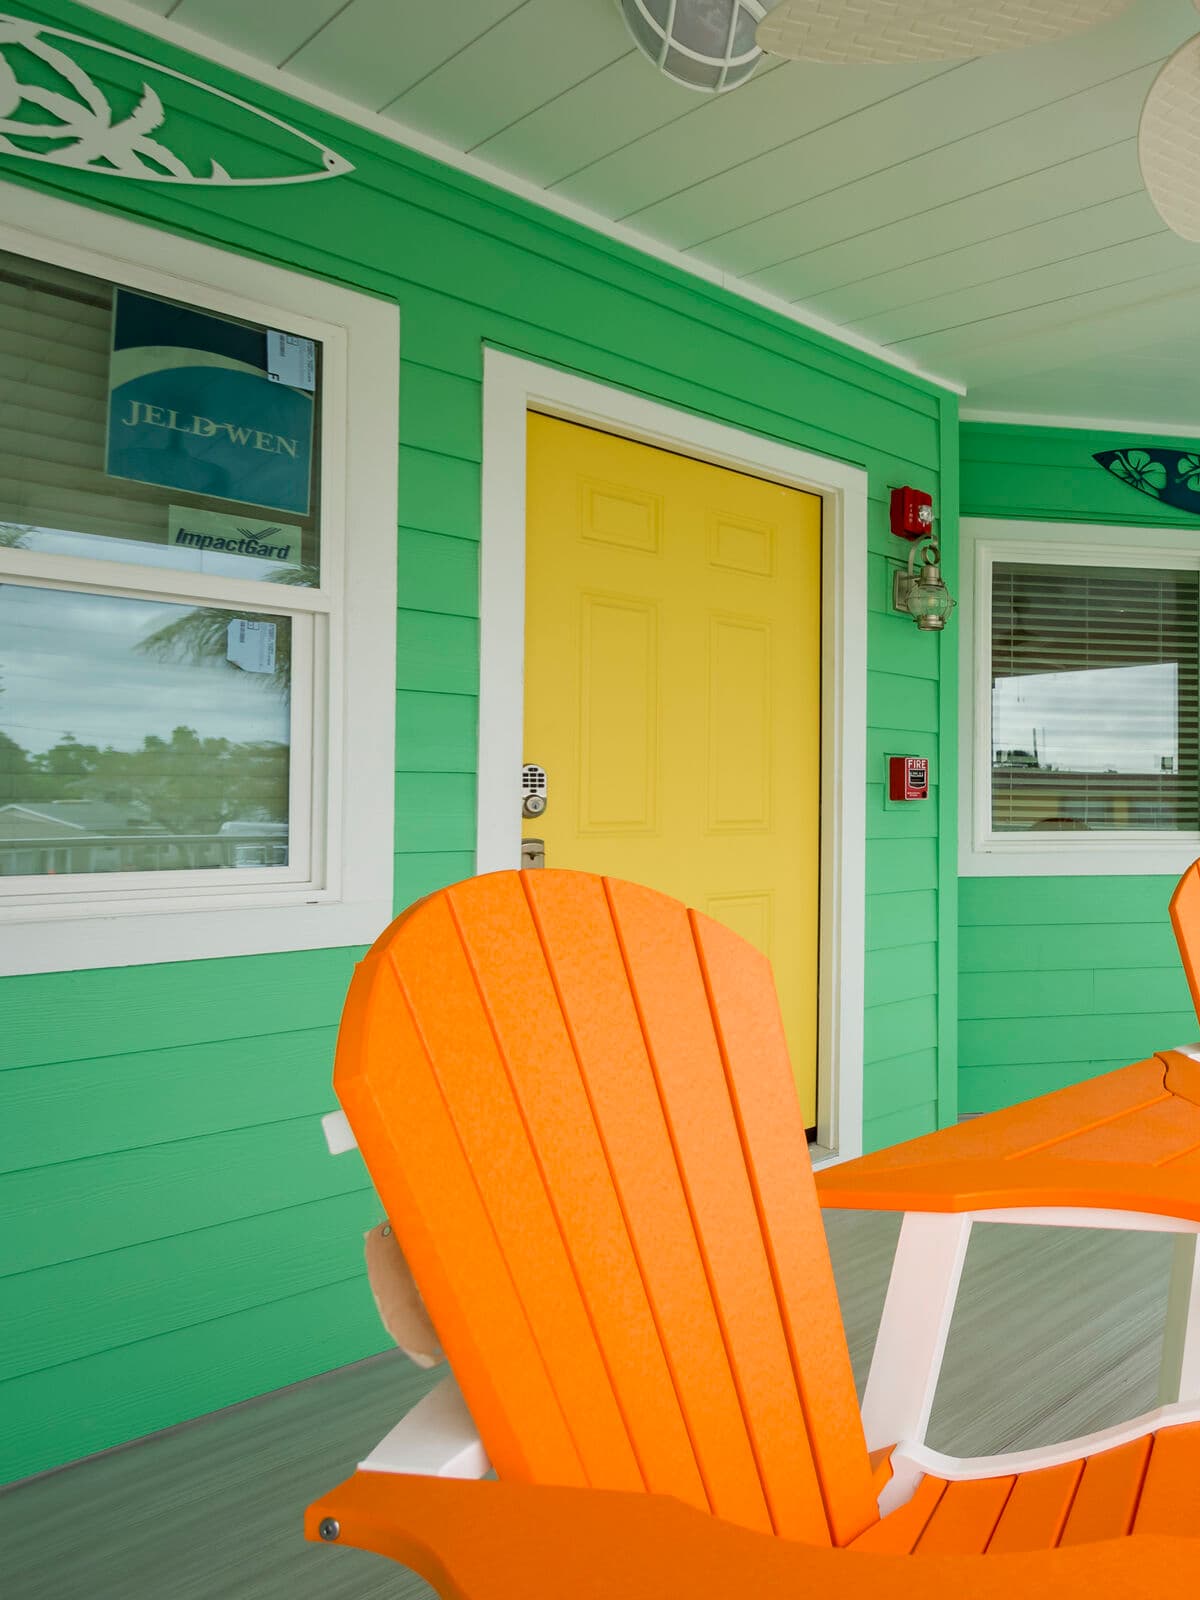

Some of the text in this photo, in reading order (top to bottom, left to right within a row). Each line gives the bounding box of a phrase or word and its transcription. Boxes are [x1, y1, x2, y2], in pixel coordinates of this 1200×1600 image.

[122, 400, 299, 459] JELD-WEN
[175, 527, 291, 561] ImpactGard
[908, 760, 926, 769] FIRE
